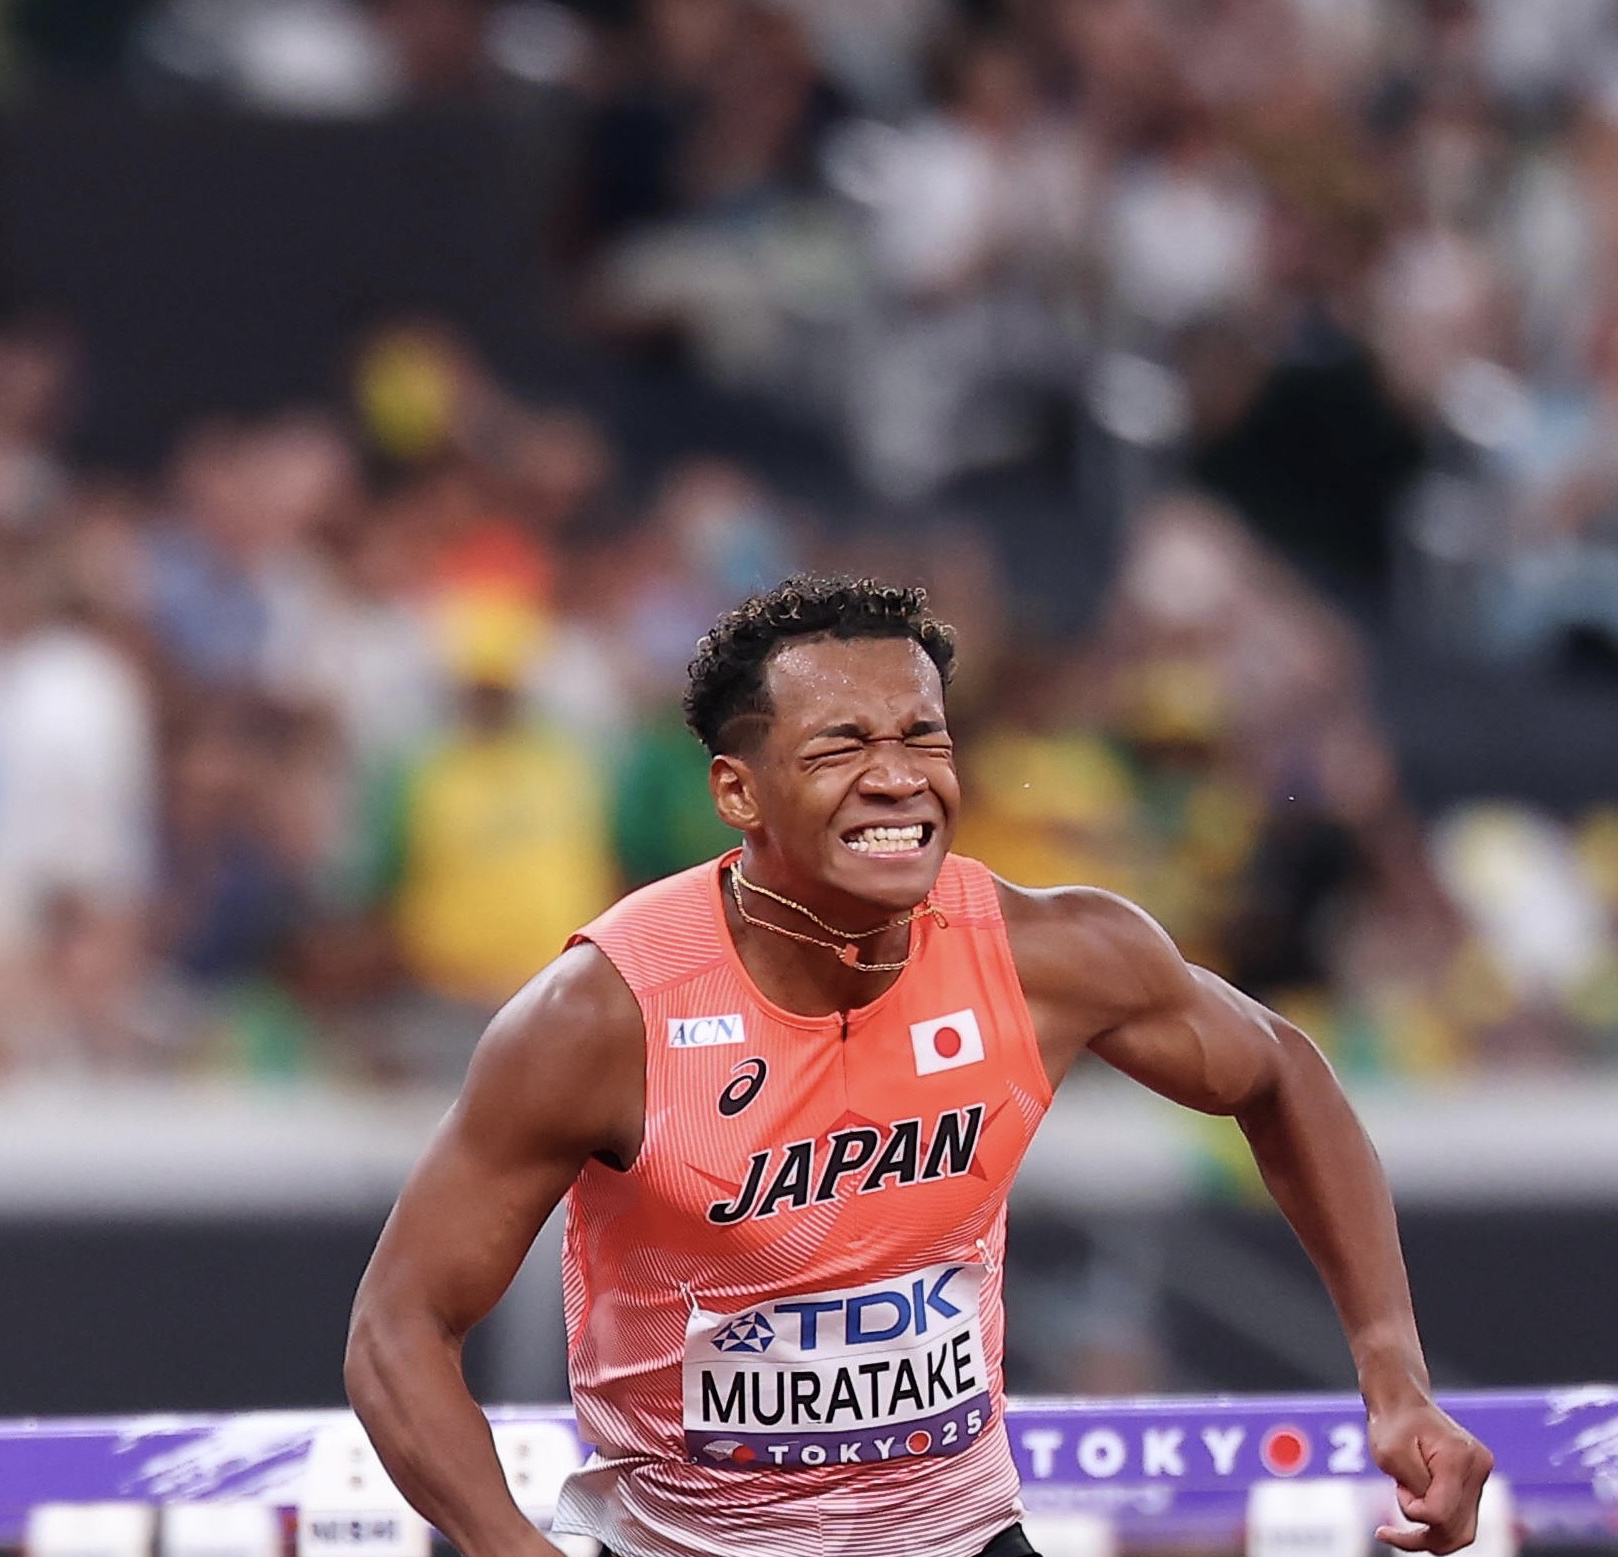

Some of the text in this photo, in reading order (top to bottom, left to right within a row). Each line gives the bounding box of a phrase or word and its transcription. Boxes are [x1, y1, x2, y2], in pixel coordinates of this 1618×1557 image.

[670, 1017, 738, 1045] ACN
[708, 1104, 986, 1225] JAPAN
[774, 1266, 965, 1350] TDK
[701, 1330, 976, 1426] MURATAKE
